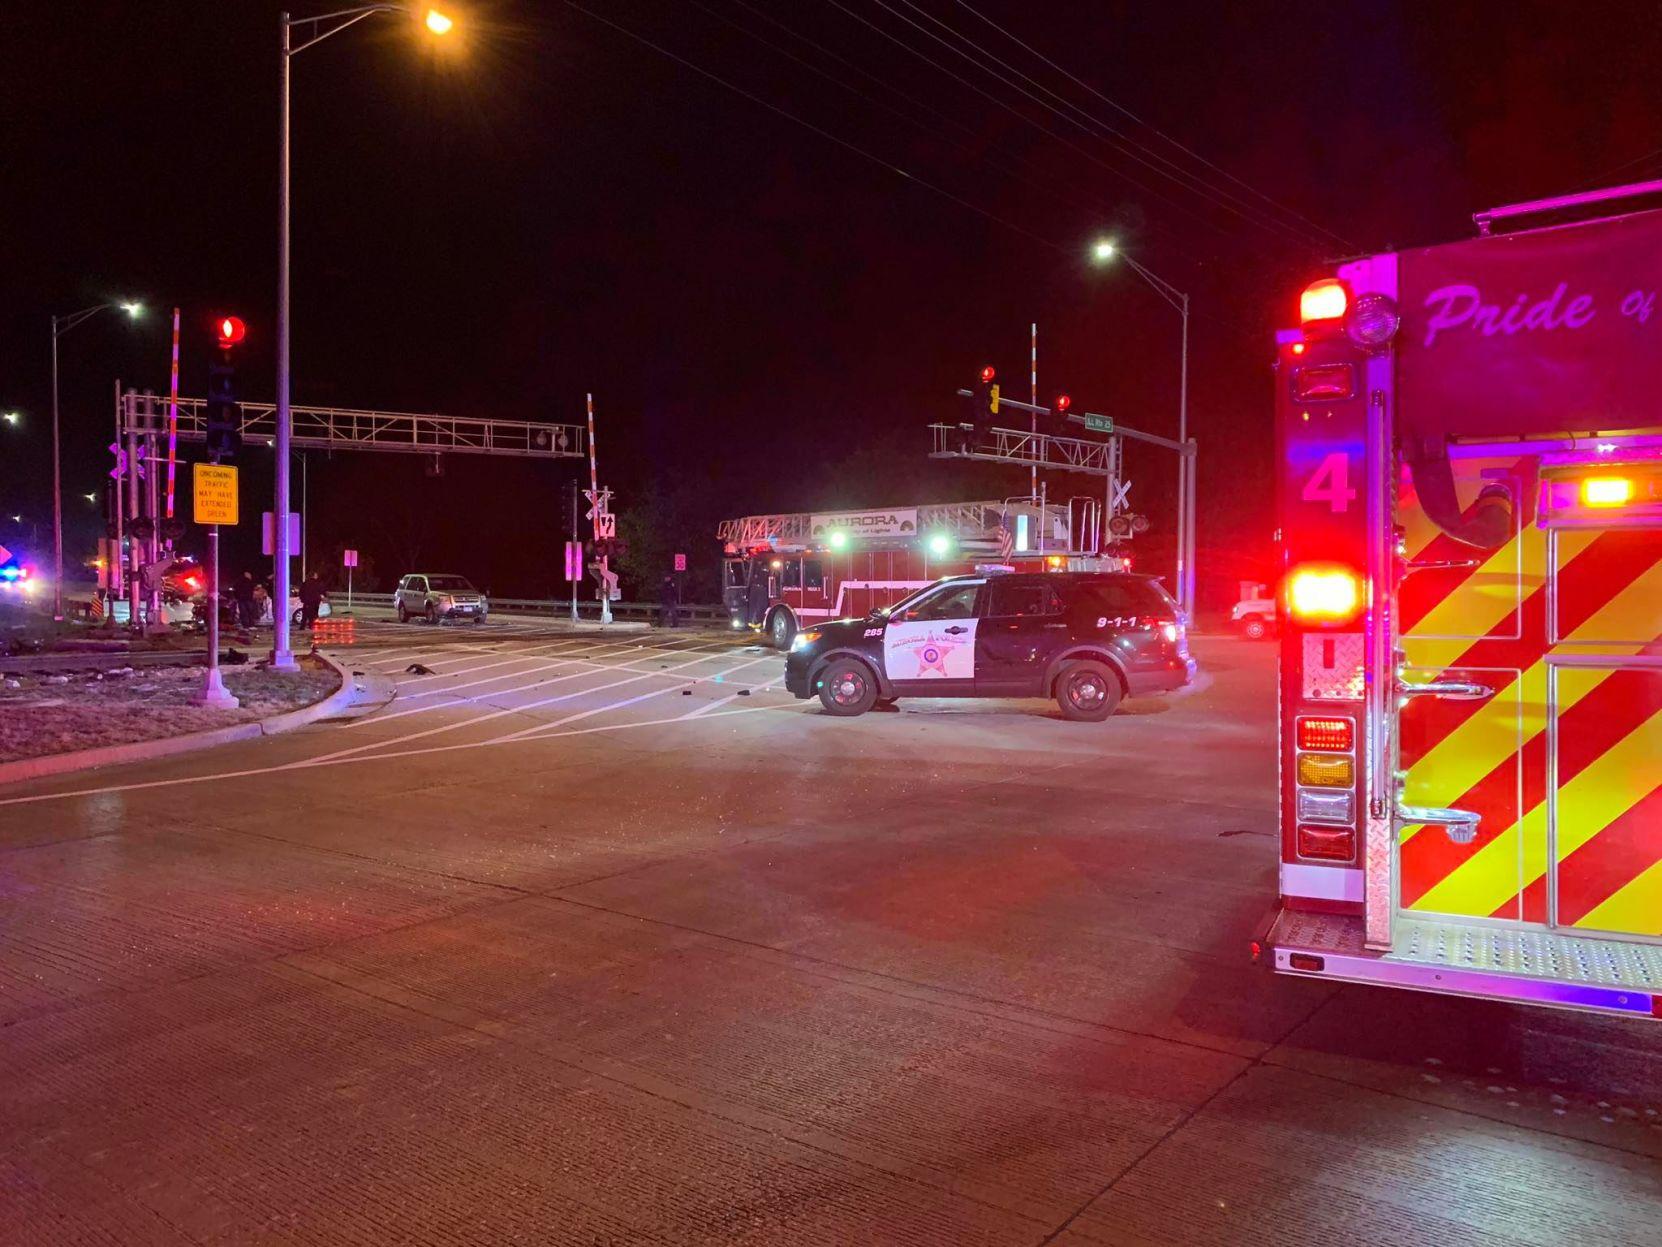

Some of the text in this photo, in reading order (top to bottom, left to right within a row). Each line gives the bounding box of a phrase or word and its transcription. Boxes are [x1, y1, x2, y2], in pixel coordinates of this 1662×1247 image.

[1424, 281, 1596, 348] Pride
[200, 470, 232, 478] ONCOMING
[205, 480, 229, 488] TRAFFIC
[1303, 453, 1356, 512] 4
[217, 491, 233, 499] HAVE
[201, 500, 232, 508] EXTENDED
[826, 515, 899, 528] AURORA
[1096, 616, 1137, 628] 9-1-1
